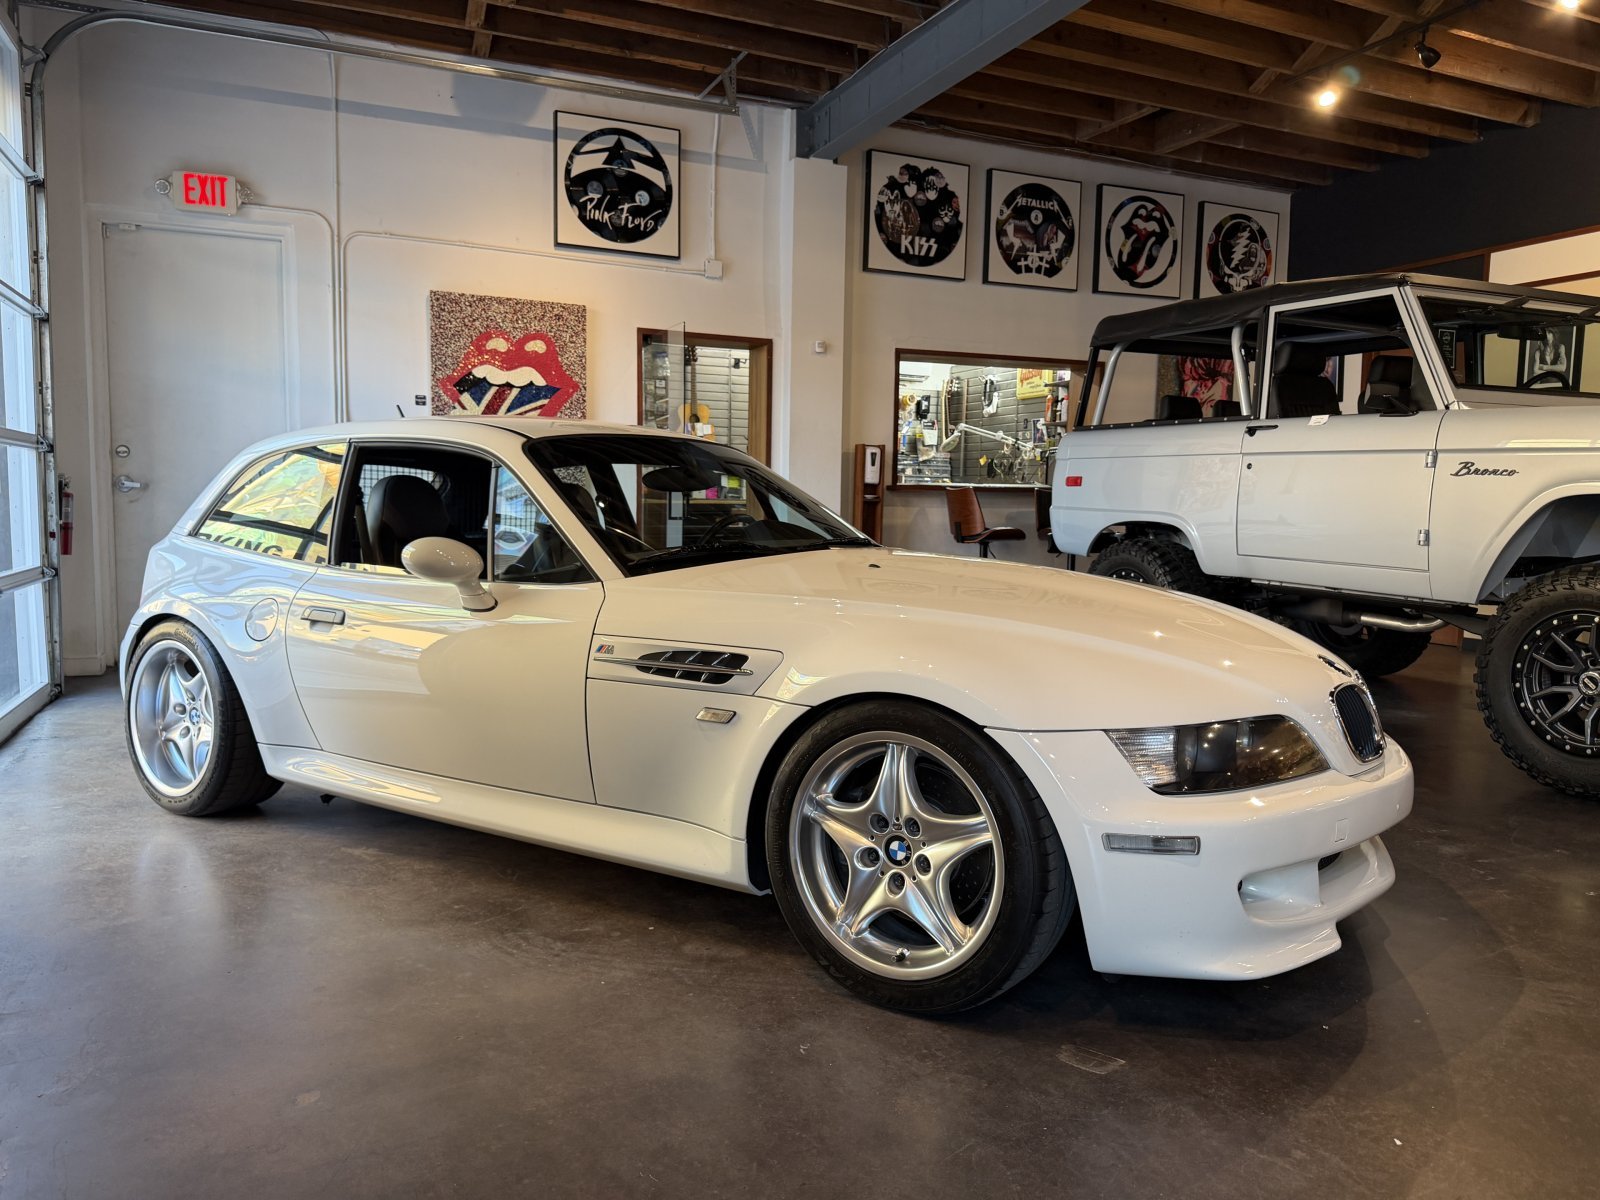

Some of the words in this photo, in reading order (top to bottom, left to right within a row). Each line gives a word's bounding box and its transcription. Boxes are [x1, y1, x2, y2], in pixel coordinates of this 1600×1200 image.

[183, 172, 228, 208] EXIT
[900, 234, 938, 258] KISS
[1449, 461, 1520, 477] Bronco
